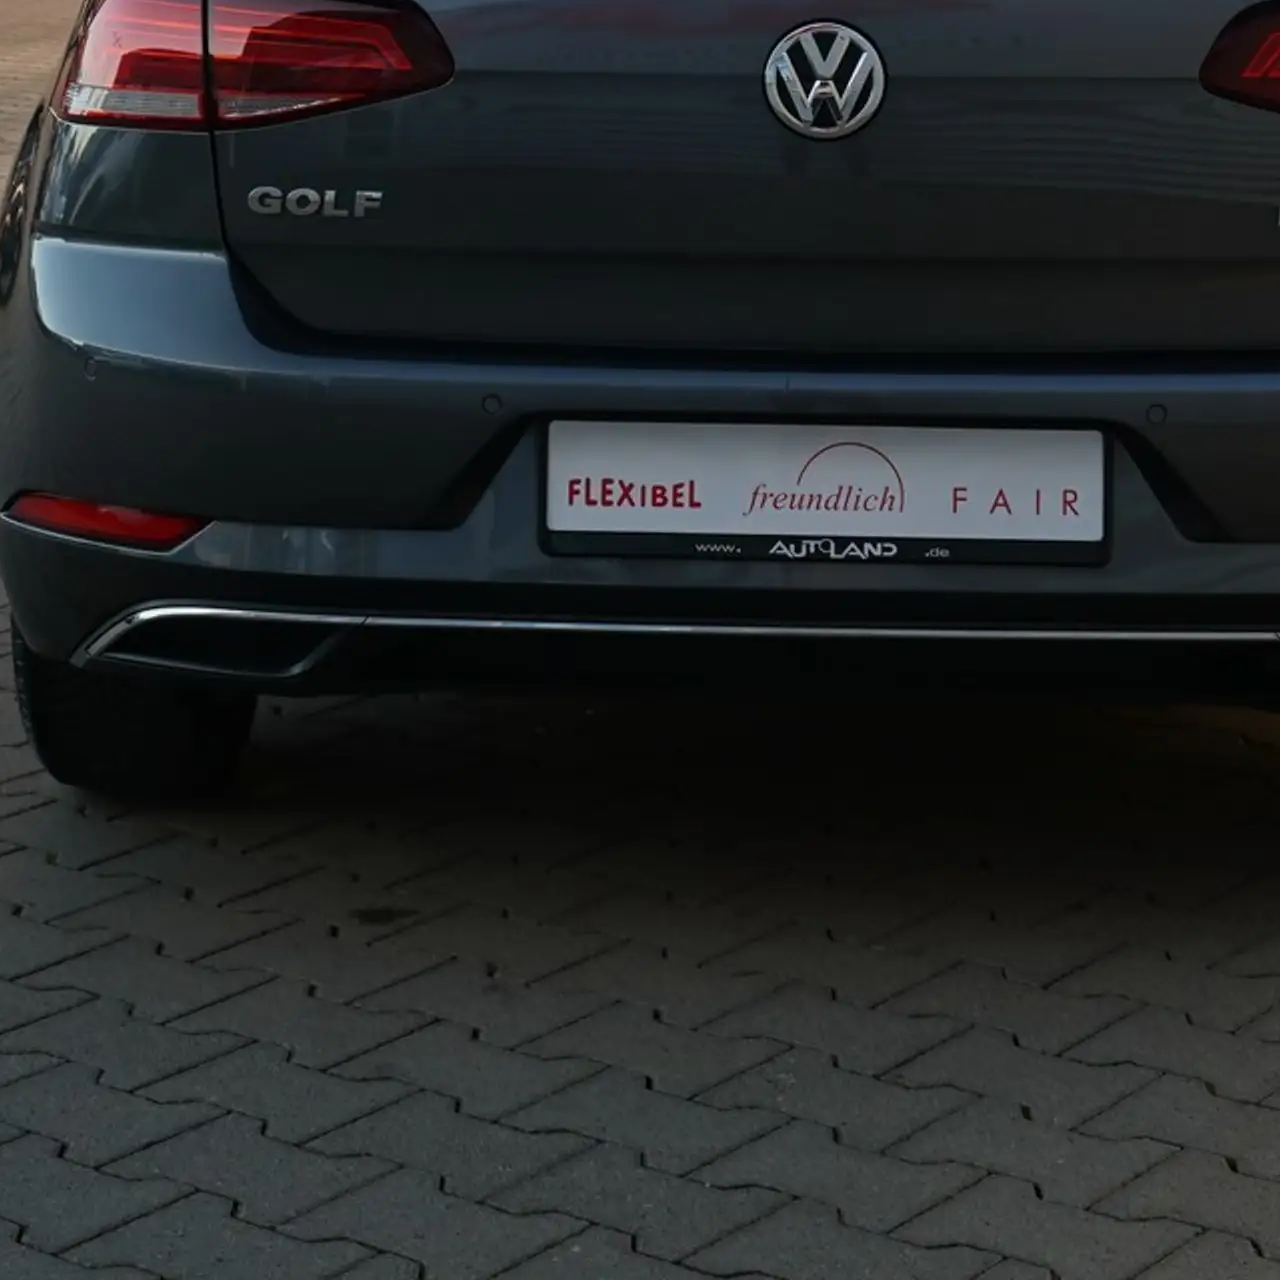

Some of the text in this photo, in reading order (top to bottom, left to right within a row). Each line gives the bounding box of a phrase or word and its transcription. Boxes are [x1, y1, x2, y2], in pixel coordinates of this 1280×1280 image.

[246, 185, 384, 219] GOLF
[568, 477, 703, 510] FLEXIBEL
[743, 482, 898, 517] freundlich
[694, 538, 951, 561] www. AUTOLAND .de
